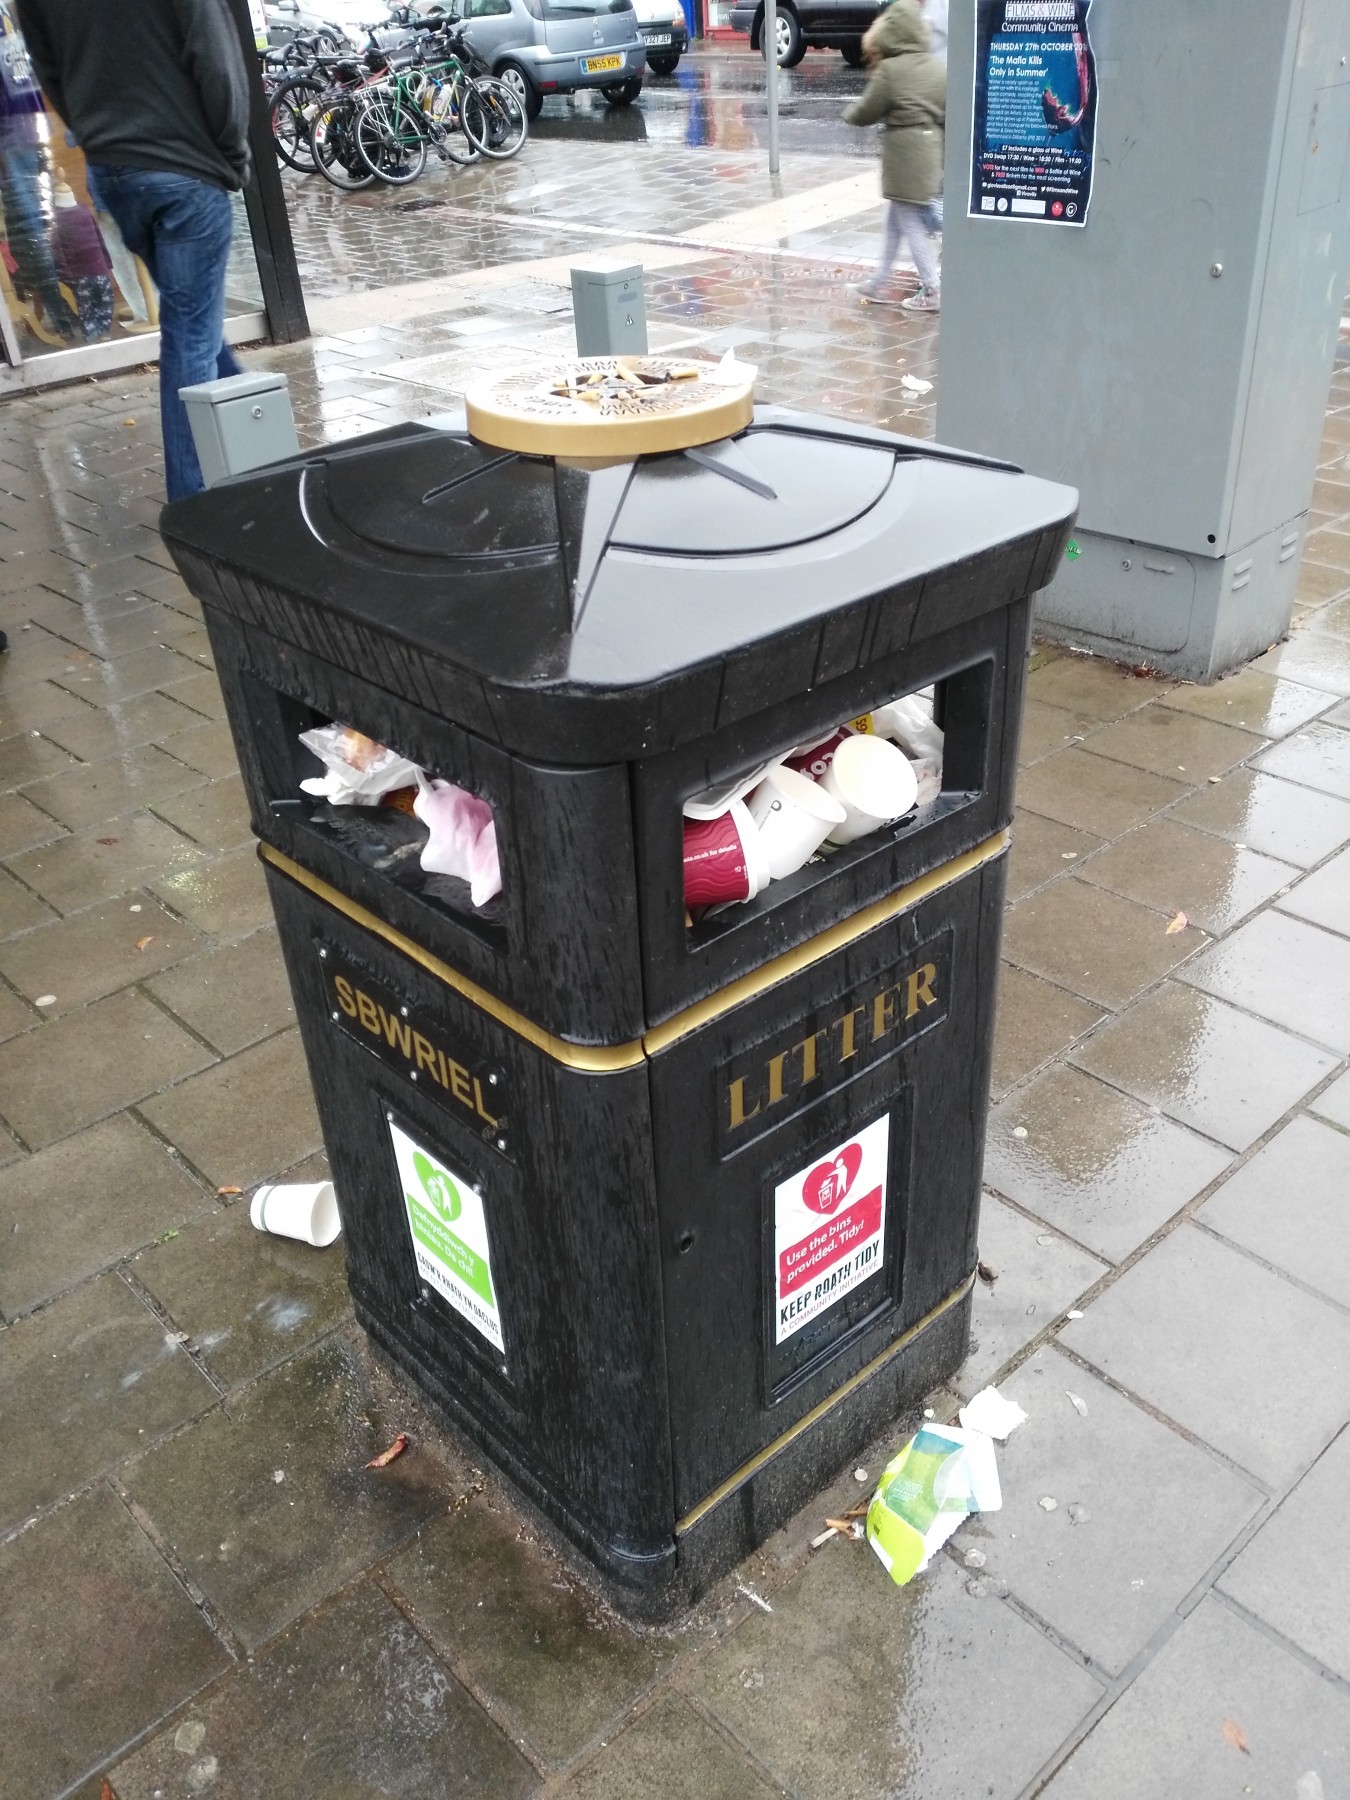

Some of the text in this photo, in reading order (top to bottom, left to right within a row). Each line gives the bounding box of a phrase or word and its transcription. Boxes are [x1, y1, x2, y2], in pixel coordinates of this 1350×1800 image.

[1006, 4, 1075, 17] FILMS & WINE
[1001, 22, 1079, 34] Community Cinema
[990, 42, 1023, 51] THURSDAY
[1025, 42, 1040, 51] 27th
[1040, 42, 1073, 51] OCTOBER
[1005, 55, 1027, 65] Mafia
[1028, 55, 1043, 65] Kills
[587, 56, 621, 71] BN55 KPK
[989, 67, 1006, 78] Only
[1007, 67, 1014, 77] in
[334, 975, 499, 1128] SBWRIEL
[728, 962, 938, 1132] LITTER
[786, 1216, 852, 1266] Use the bins
[786, 1219, 865, 1285] provided. Tidy!
[780, 1239, 880, 1326] KEEP ROATH TIDY
[780, 1259, 879, 1336] A COMMUNITY INITIATIVE
